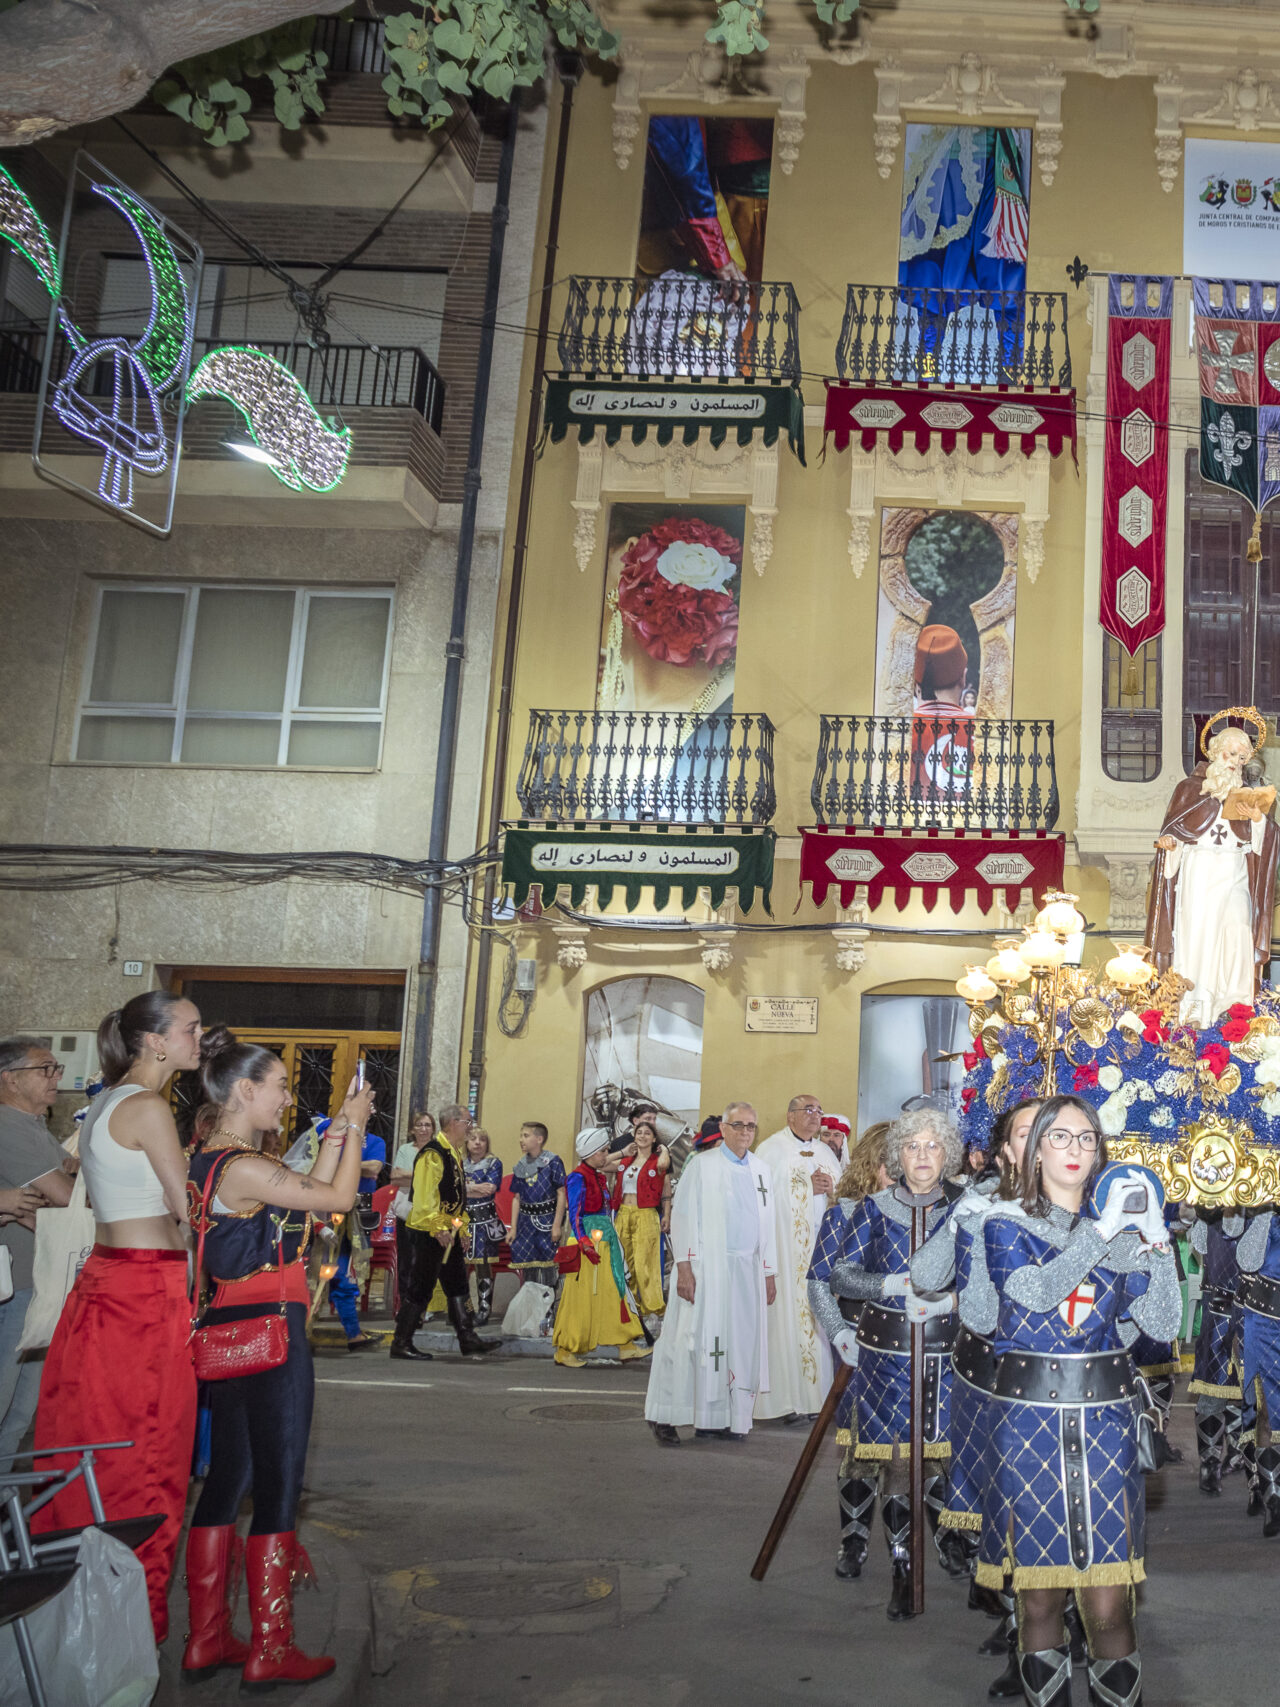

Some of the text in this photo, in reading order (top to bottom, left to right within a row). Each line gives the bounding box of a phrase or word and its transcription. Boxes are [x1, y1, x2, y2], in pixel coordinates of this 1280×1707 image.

[1218, 213, 1243, 221] CENTRAL
[1233, 221, 1267, 230] CRISTIANOS
[128, 964, 139, 973] 10
[770, 1003, 794, 1011] CALLE
